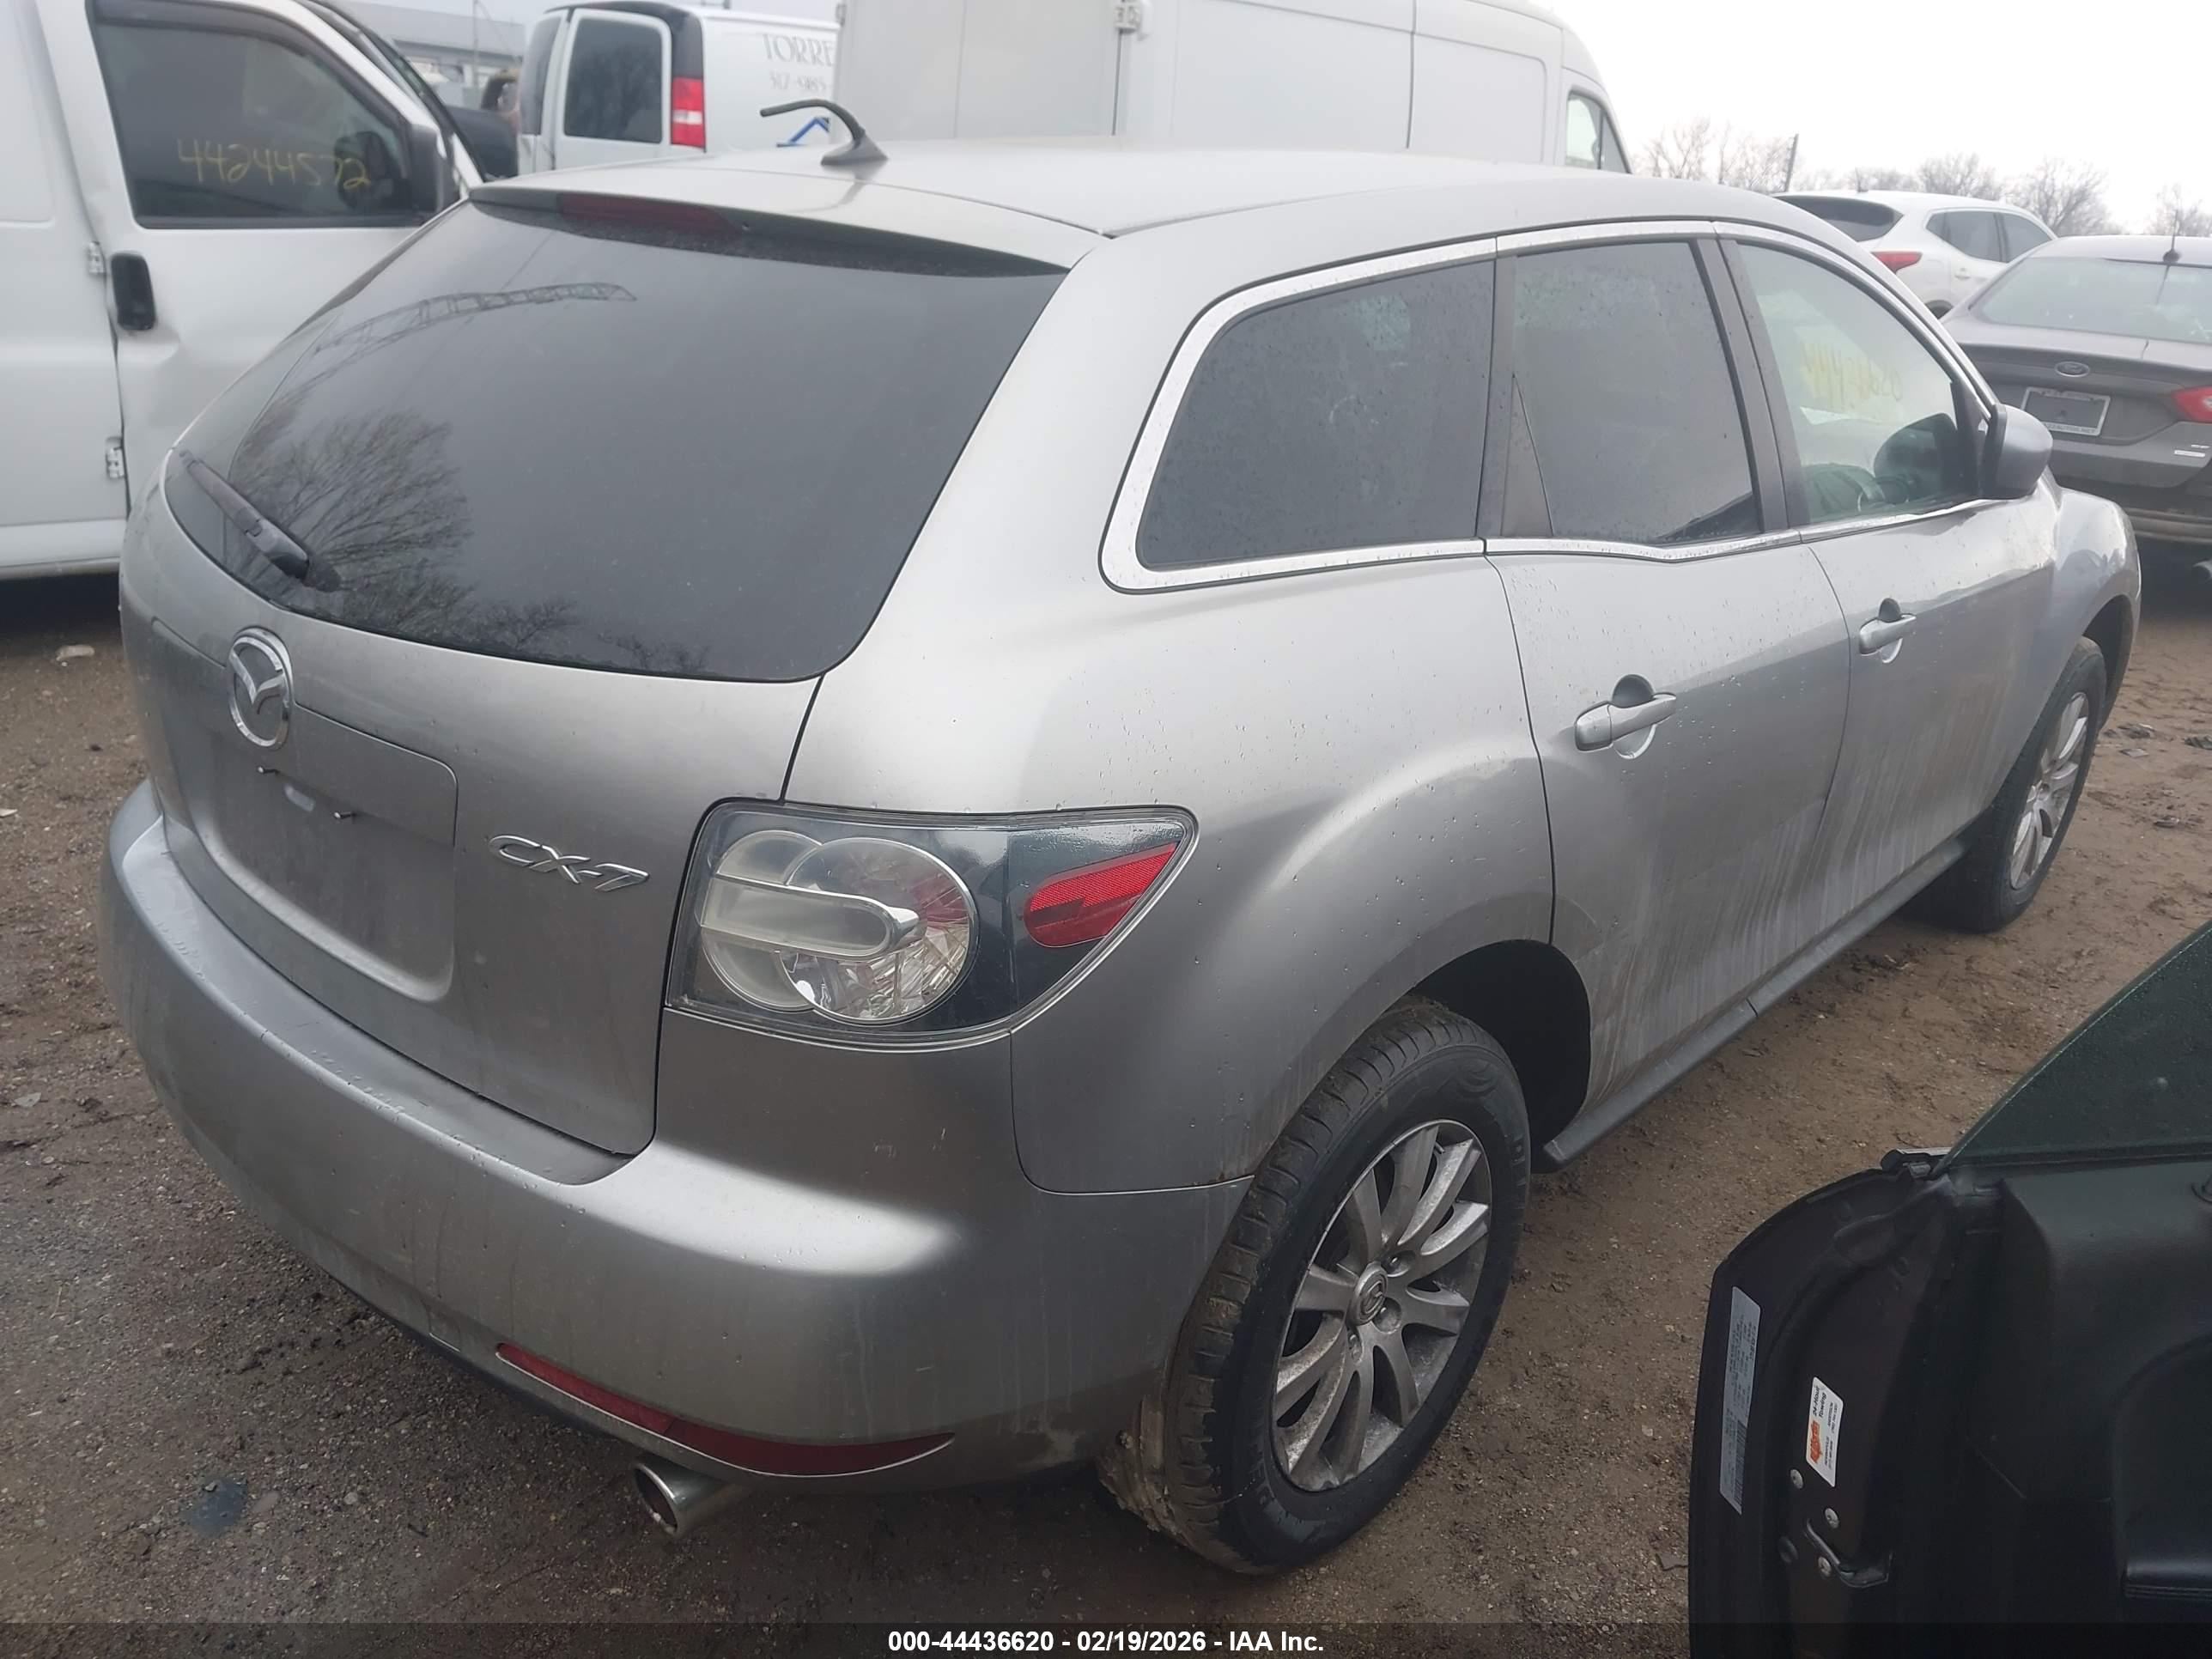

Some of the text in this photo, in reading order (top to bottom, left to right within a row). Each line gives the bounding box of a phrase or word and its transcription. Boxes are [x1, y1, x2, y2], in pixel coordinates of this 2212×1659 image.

[177, 137, 371, 190] 44244572
[488, 834, 650, 892] CX-7
[1819, 1392, 1827, 1419] Towing
